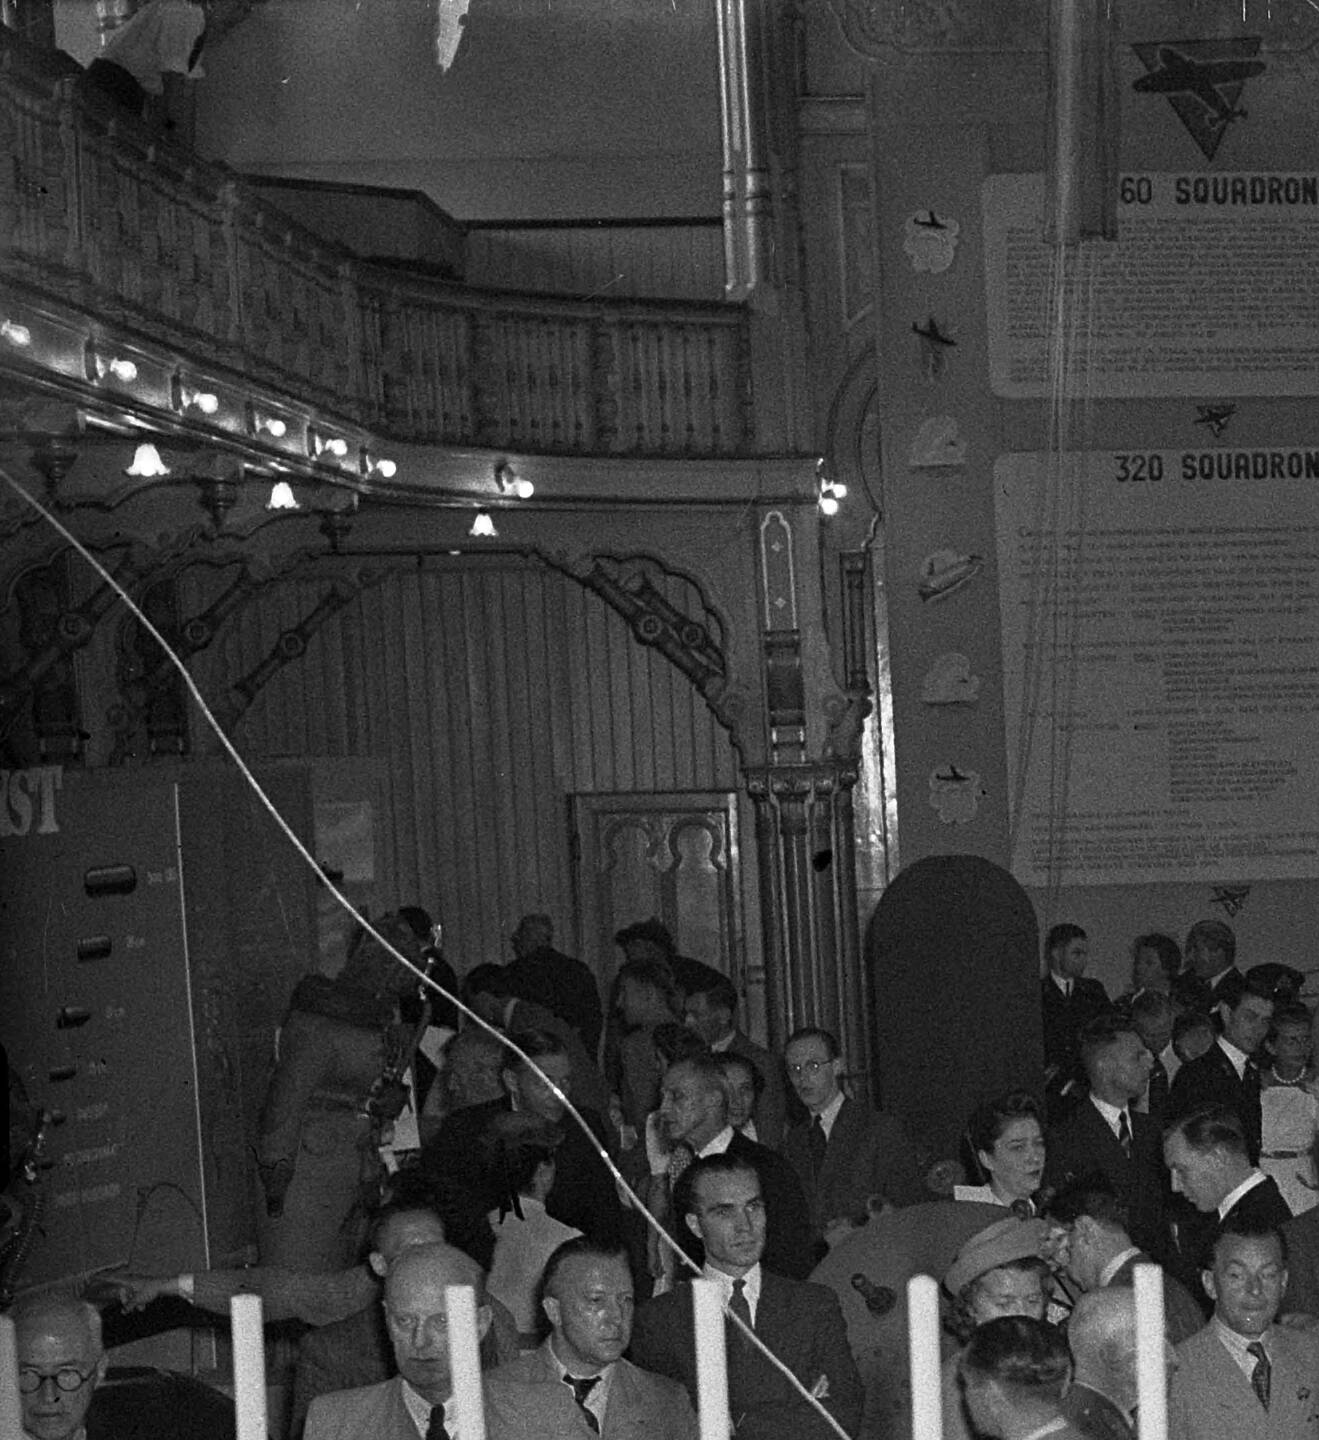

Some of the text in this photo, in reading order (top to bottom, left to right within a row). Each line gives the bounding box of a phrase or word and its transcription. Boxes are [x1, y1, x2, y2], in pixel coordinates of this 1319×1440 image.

[1119, 177, 1319, 206] 60 SQUADRON
[1113, 454, 1164, 482] 320
